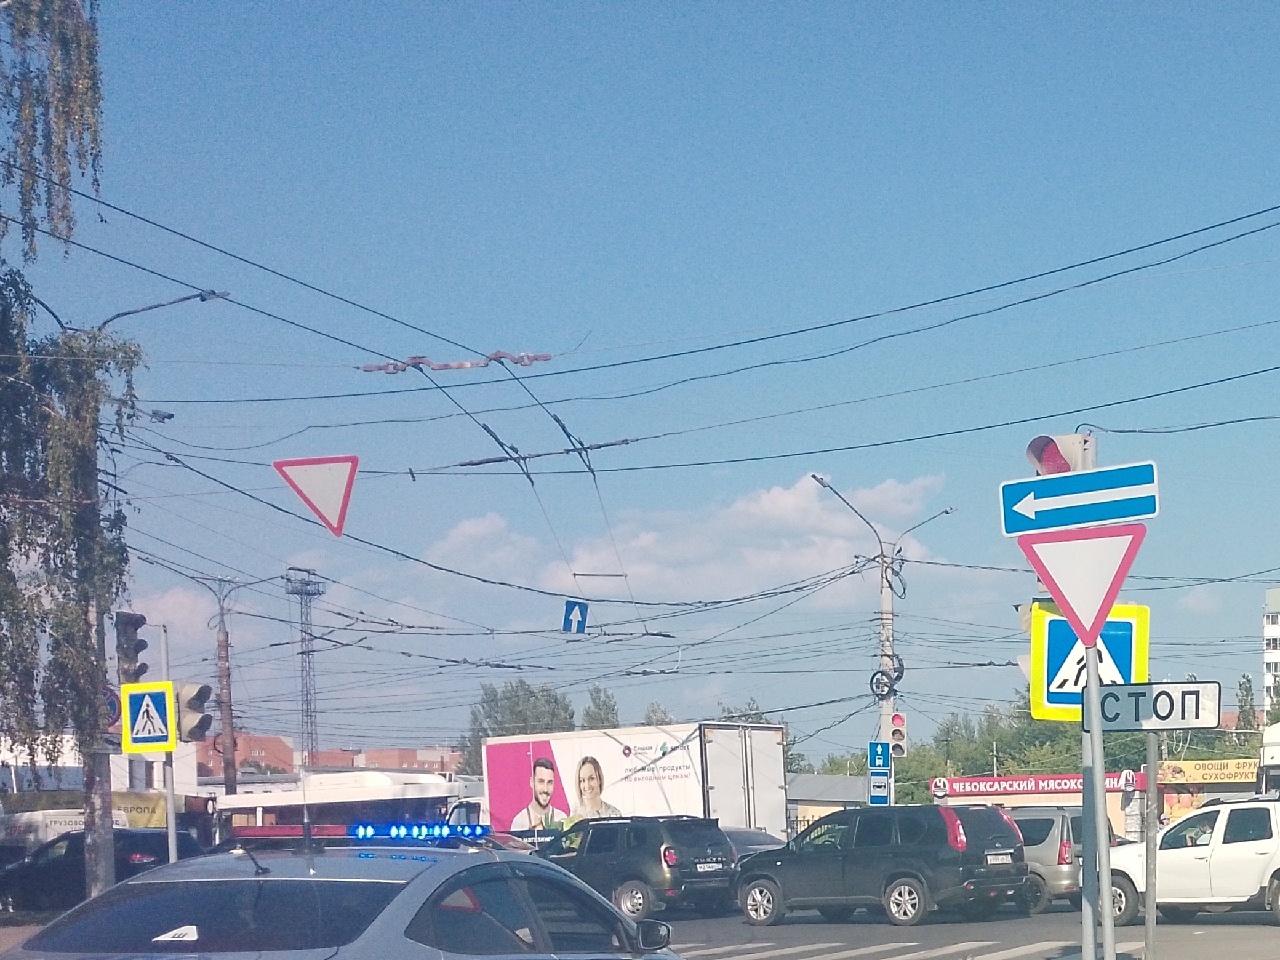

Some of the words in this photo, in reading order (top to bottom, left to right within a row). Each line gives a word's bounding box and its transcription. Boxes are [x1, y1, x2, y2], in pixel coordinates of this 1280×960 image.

[1100, 690, 1200, 722] СТОП
[1194, 763, 1229, 771] ОВОЩИ
[1202, 772, 1257, 780] СУХОФРУКТ
[952, 778, 1035, 793] ЧЕБОКСАРСКИЙ
[1038, 776, 1123, 791] МЯСОКОИНА
[117, 806, 156, 814] ЕВРОПА
